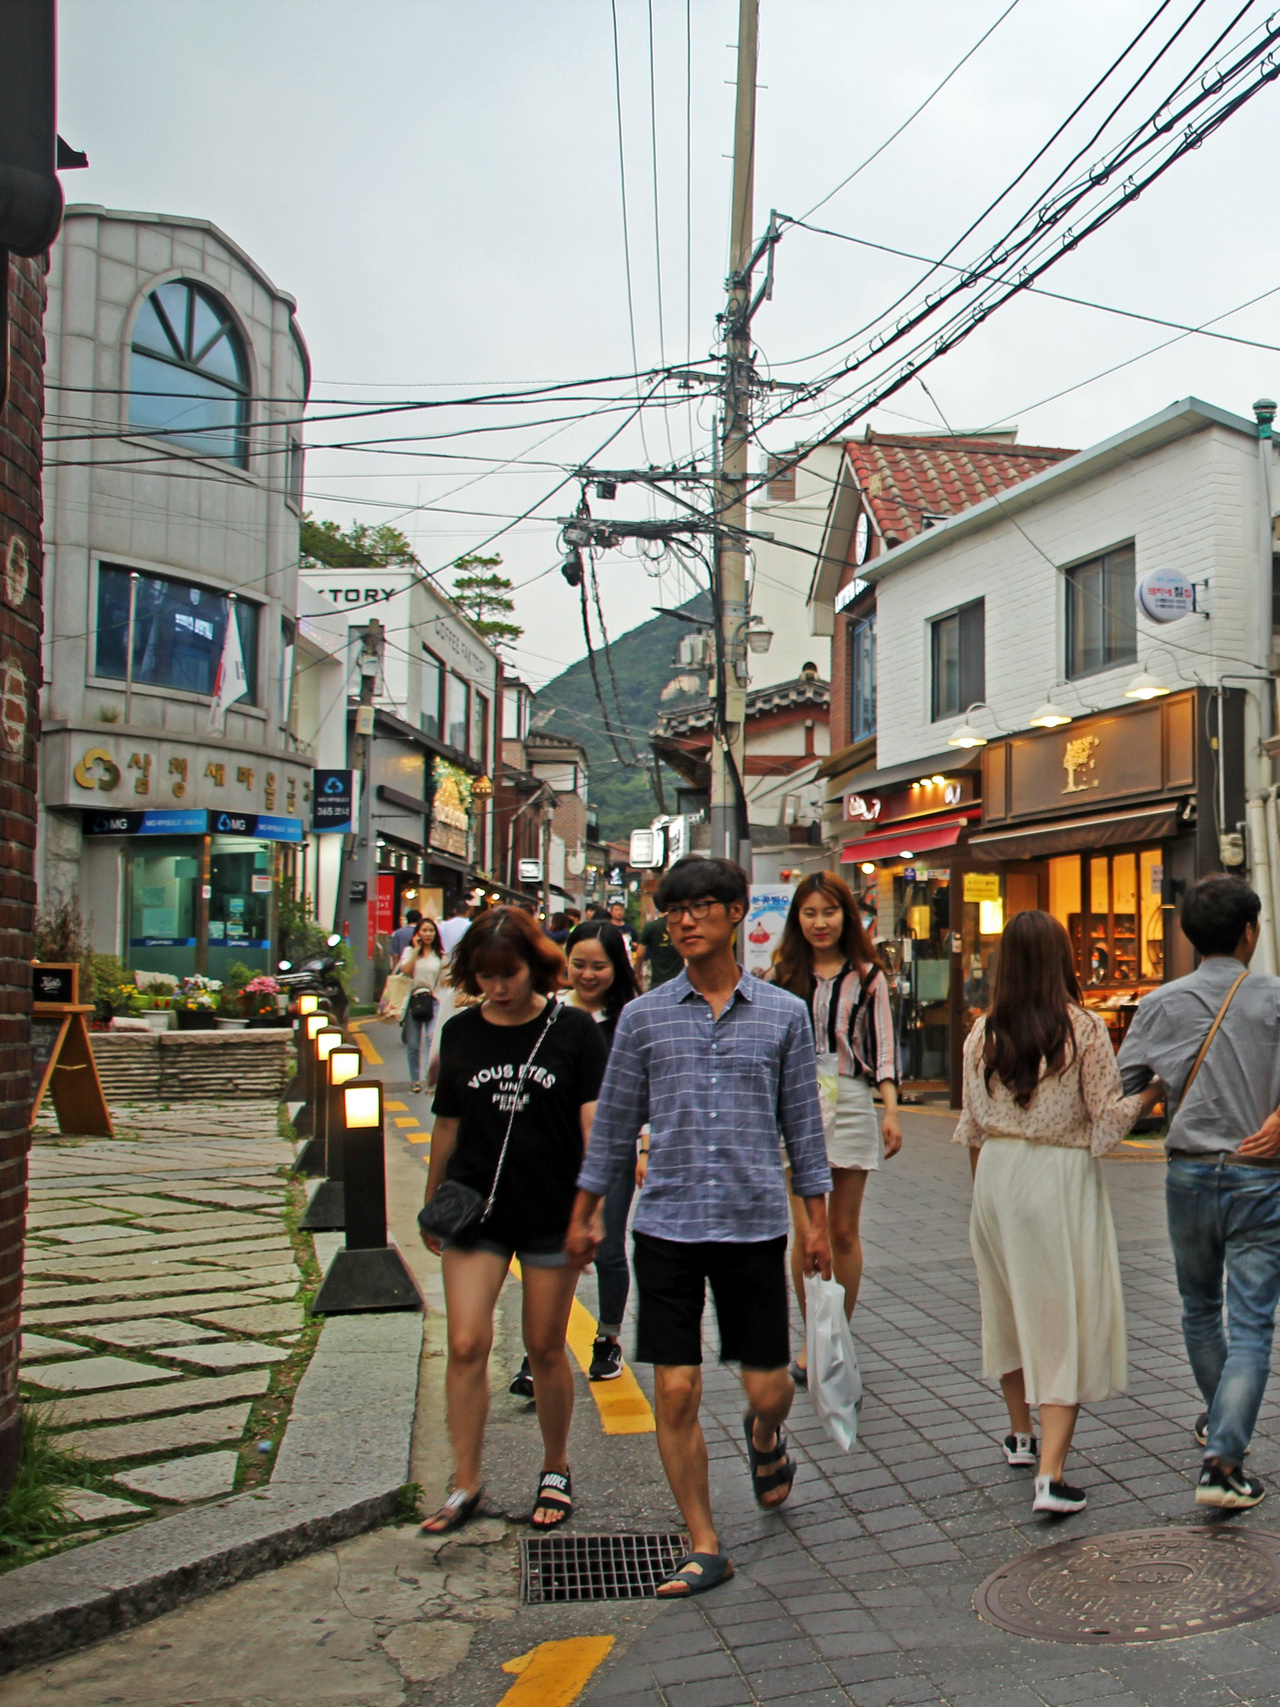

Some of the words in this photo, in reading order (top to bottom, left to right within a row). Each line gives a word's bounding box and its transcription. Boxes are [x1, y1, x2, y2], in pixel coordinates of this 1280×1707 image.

[317, 588, 396, 602] TORY
[109, 818, 128, 830] MG
[231, 819, 246, 831] MG
[467, 1064, 514, 1090] VOUS
[541, 1473, 568, 1490] NIKE
